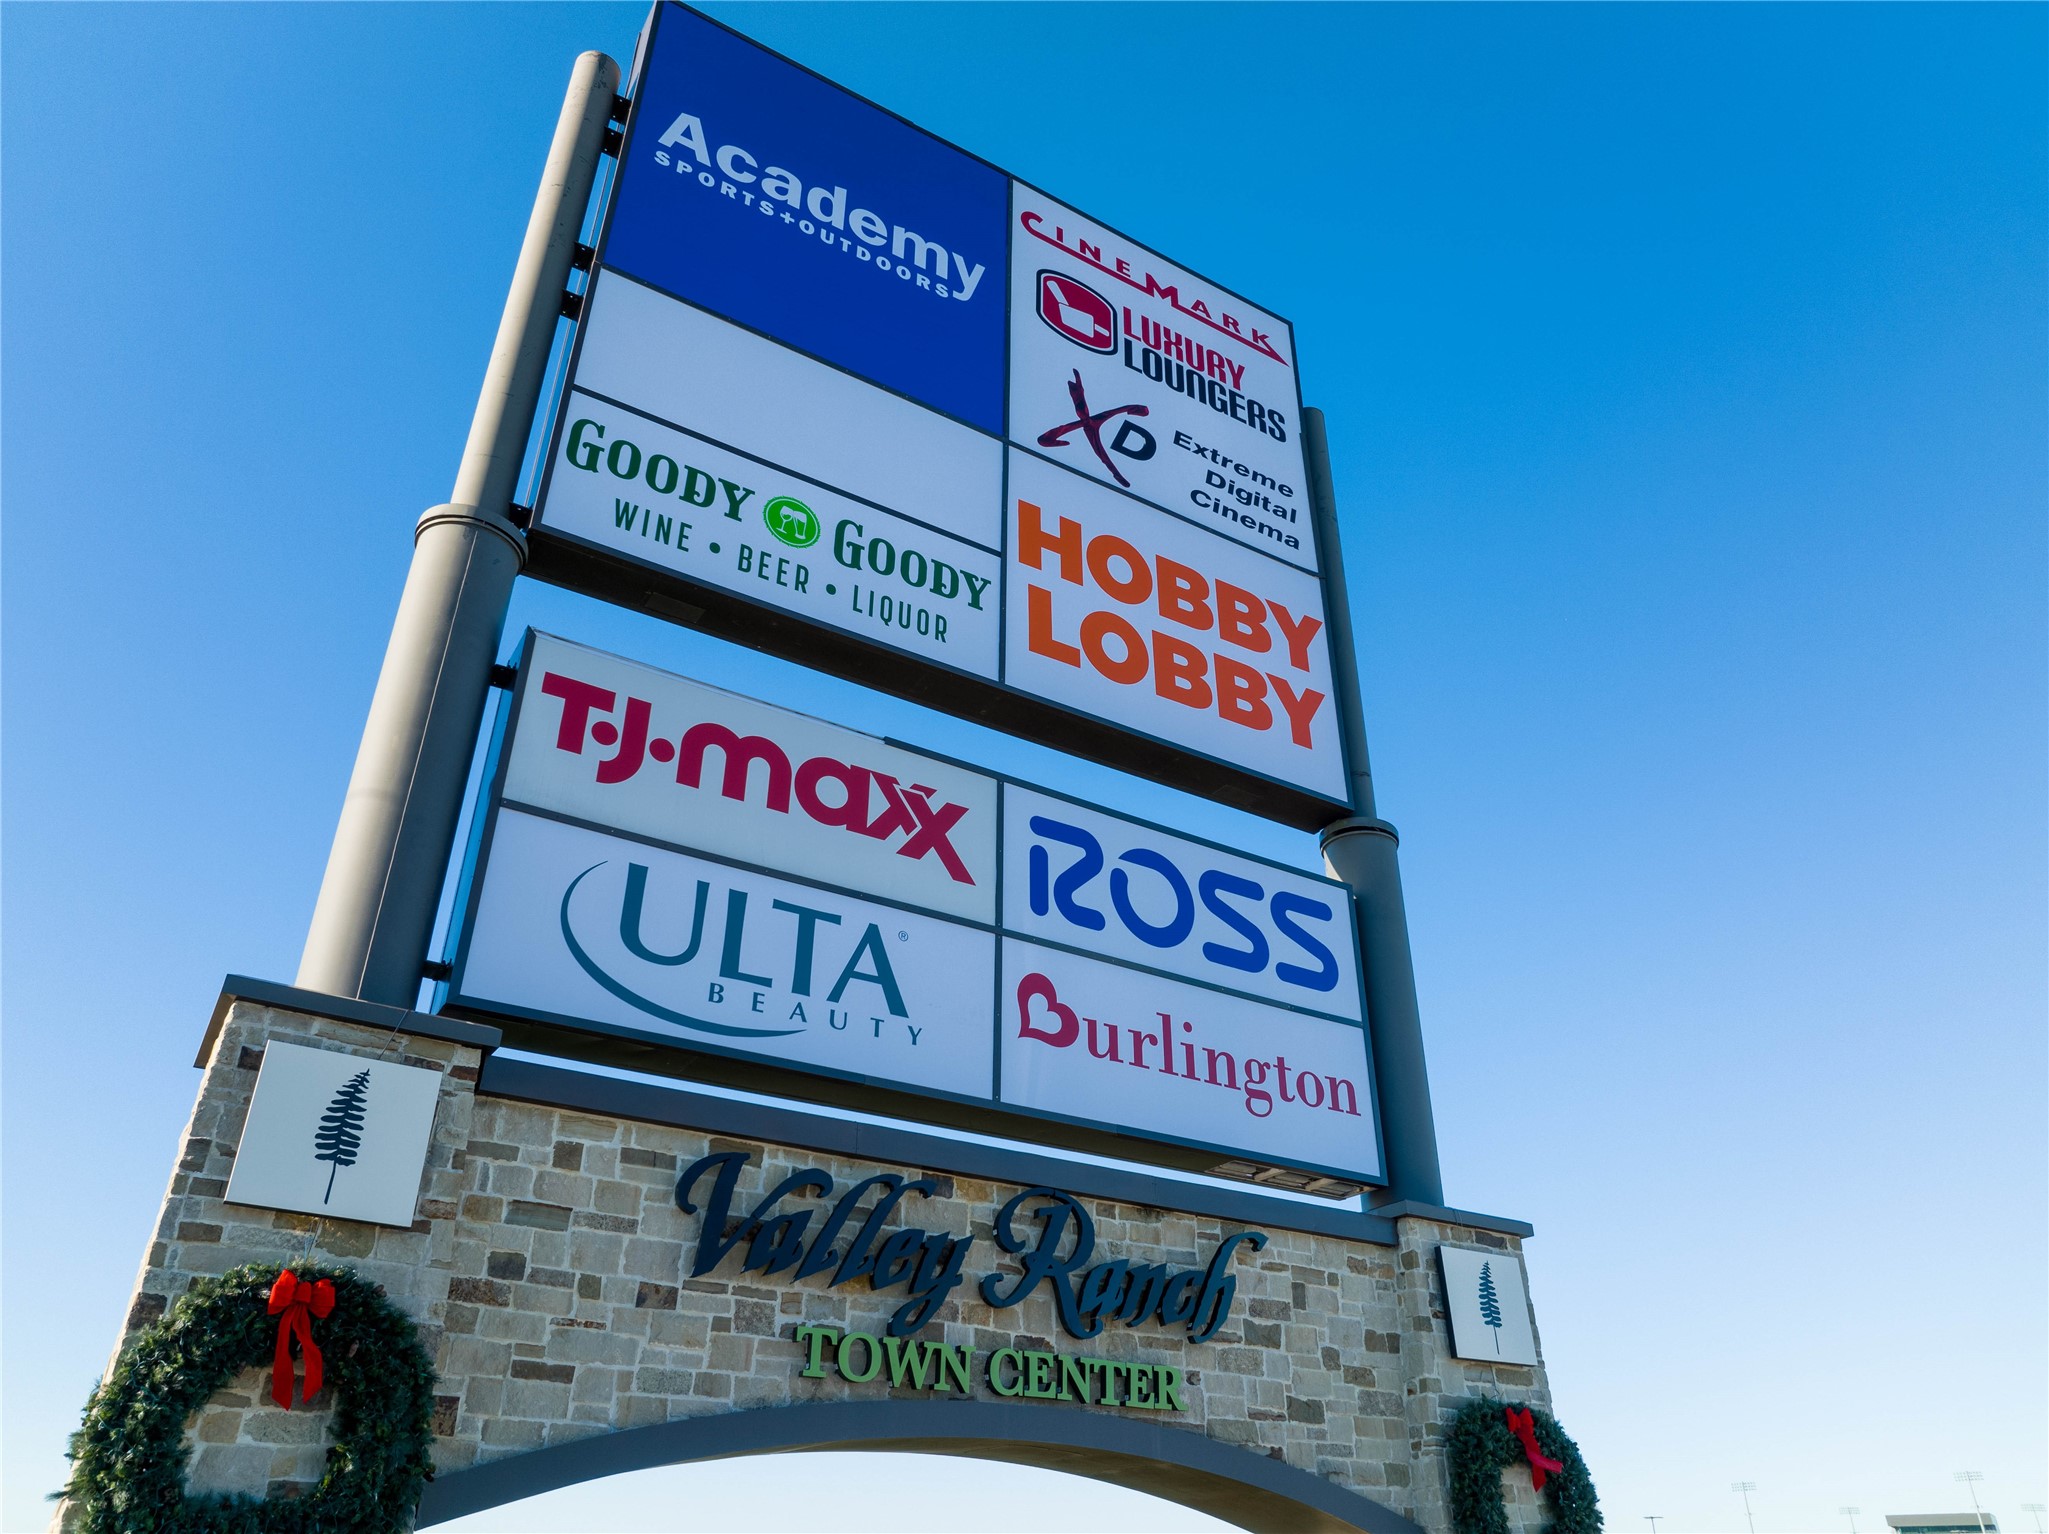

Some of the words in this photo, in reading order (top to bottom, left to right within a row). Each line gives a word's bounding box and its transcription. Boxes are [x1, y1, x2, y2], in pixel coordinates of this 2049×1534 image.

[658, 112, 985, 301] Academy
[1021, 211, 1290, 367] CINEMARK
[1123, 306, 1245, 390] LUXURY
[1037, 368, 1157, 487] XD
[1124, 340, 1286, 442] LOUNGERS
[566, 418, 755, 522] GOODY
[834, 519, 991, 611] GOODY
[1173, 430, 1294, 497] Extreme
[1190, 489, 1300, 550] Cinema
[1205, 469, 1297, 523] Digital
[615, 498, 692, 552] WINE
[737, 544, 809, 594] BEER
[852, 585, 947, 642] LIQUOR
[1018, 499, 1323, 672] HOBBY
[1028, 583, 1325, 750] LOBBY
[1029, 815, 1339, 992] ROSS
[708, 982, 923, 1046] BEAUTY
[1017, 973, 1361, 1118] Burlington
[675, 1152, 975, 1337] Valley
[979, 1187, 1269, 1344] Ranch
[795, 1325, 976, 1394] TOWN
[984, 1348, 1188, 1411] CENTER
